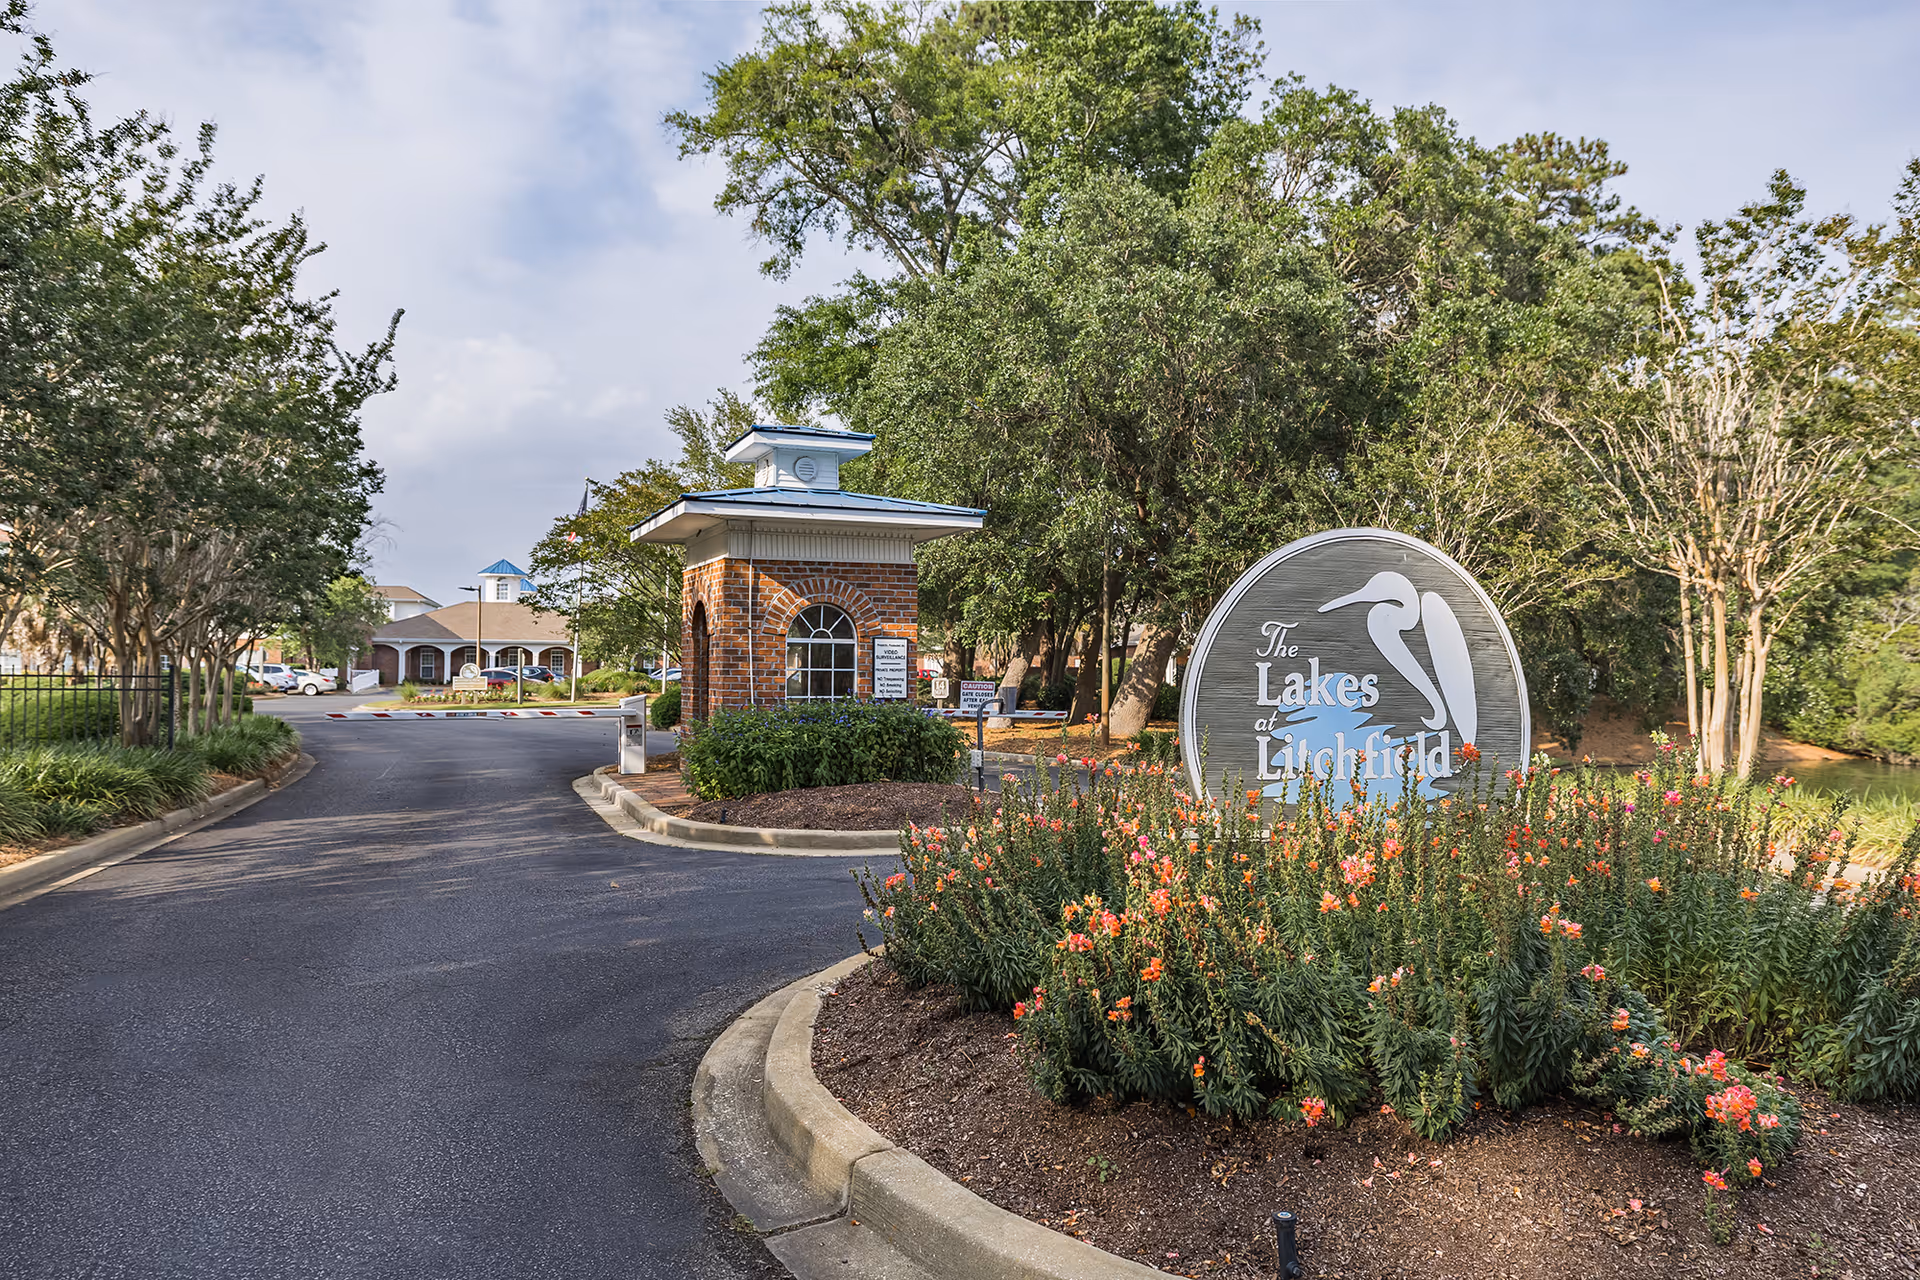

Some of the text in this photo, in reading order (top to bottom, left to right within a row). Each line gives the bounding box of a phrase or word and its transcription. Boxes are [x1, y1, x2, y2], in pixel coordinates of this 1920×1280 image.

[1256, 621, 1299, 658] The
[1255, 656, 1380, 708] Lakes
[1254, 711, 1278, 732] at
[1255, 730, 1453, 781] Litchfield
